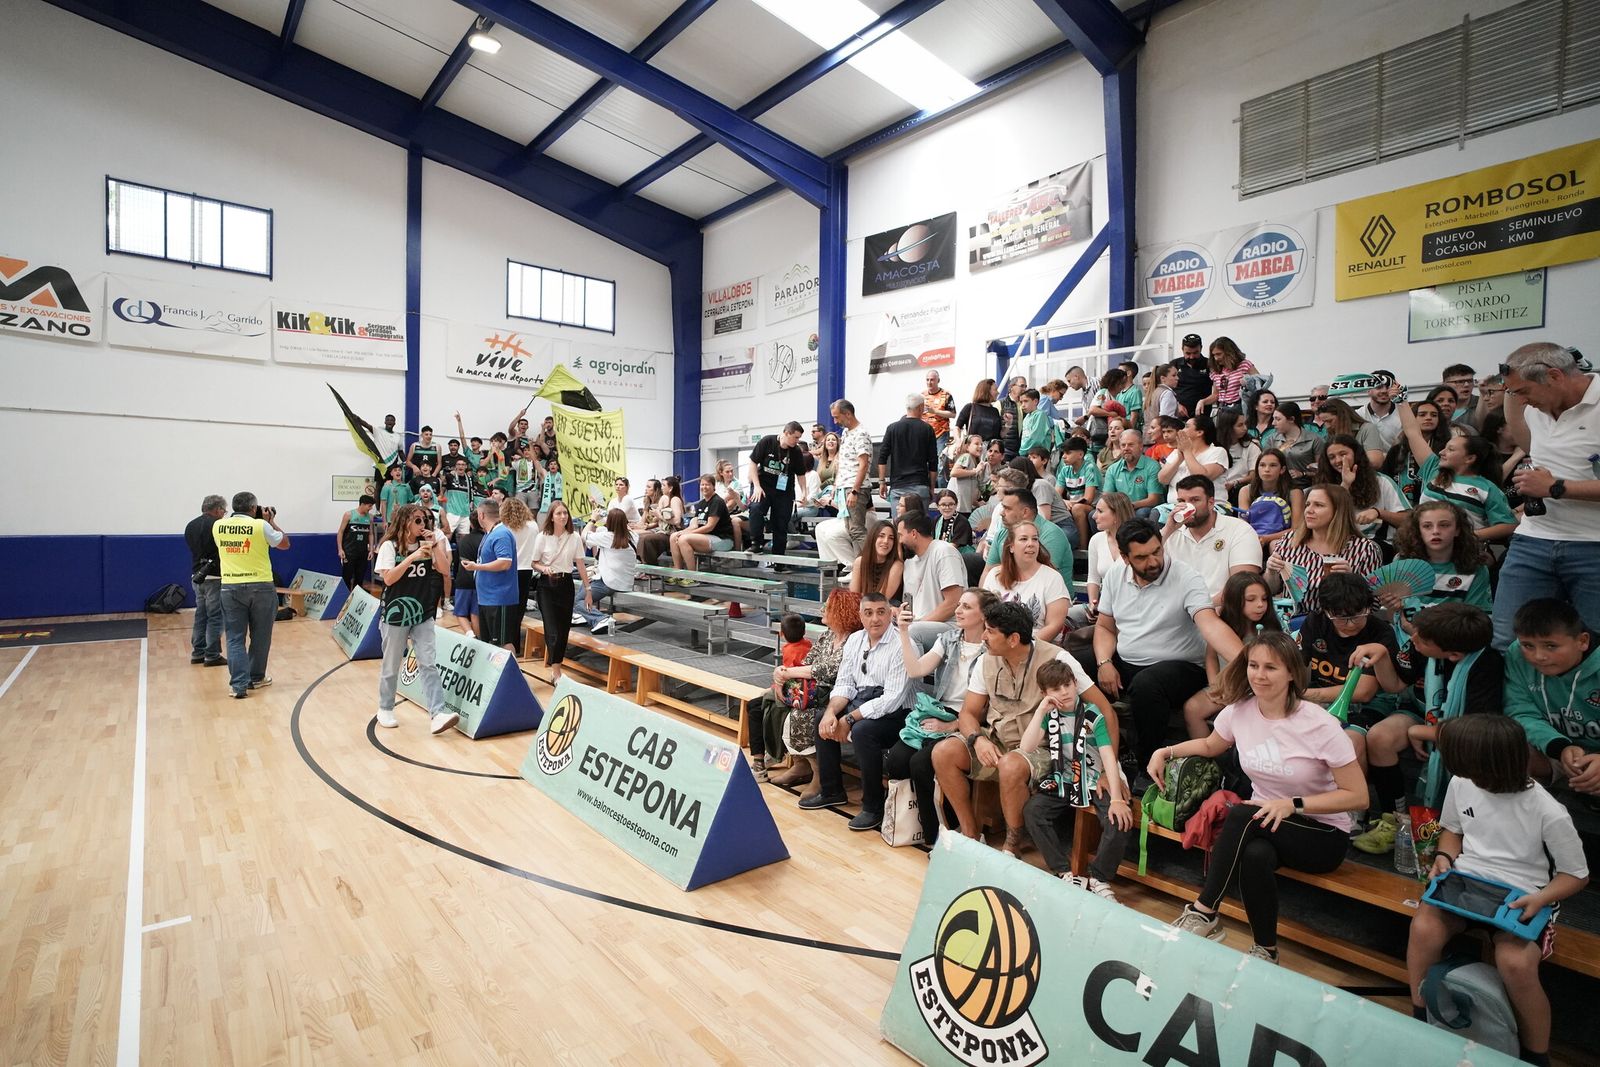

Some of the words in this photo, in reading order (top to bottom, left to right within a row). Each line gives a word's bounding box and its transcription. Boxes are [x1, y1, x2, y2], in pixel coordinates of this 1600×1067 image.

[1425, 170, 1585, 219] ROMBOSOL
[1424, 217, 1458, 229] Estepona
[1464, 209, 1499, 221] Marbella
[1505, 198, 1549, 213] Fuengirola
[1557, 189, 1585, 202] Ronda
[1508, 207, 1583, 231] SEMINUEVO
[1435, 230, 1475, 246] NUEVO
[1435, 240, 1487, 257] OCASIÓN
[1242, 239, 1288, 260] RADIO
[875, 258, 940, 283] AMACOSTA
[1160, 257, 1200, 275] RADIO
[1235, 255, 1294, 281] MARCA
[1348, 255, 1406, 273] RENAULT
[1421, 259, 1472, 273] rombosol.com
[708, 282, 752, 304] VILLALOBOS
[1153, 271, 1205, 295] MARCA
[1458, 281, 1493, 295] PISTA
[731, 299, 754, 312] ESTEPONA
[1246, 298, 1277, 308] MÁLAGA
[20, 306, 92, 323] EXCAVACIONES
[163, 305, 198, 317] Francis
[200, 310, 206, 320] J.
[227, 313, 263, 325] Garrido
[1425, 314, 1470, 329] TORRES
[1473, 306, 1528, 323] BENÍTEZ
[456, 366, 464, 374] la
[466, 368, 492, 378] marca
[494, 371, 507, 379] del
[510, 373, 544, 385] deporte
[589, 359, 656, 376] agrojardín
[218, 524, 253, 535] prensa
[407, 562, 426, 578] 26
[313, 579, 327, 591] CAB
[450, 644, 476, 669] CAB
[435, 663, 484, 706] TEPONA
[538, 737, 571, 771] ESTEPONA
[627, 726, 678, 771] CAB
[578, 744, 702, 838] ESTEPONA
[577, 787, 679, 858] www.baloncestoestepona.com
[915, 967, 1039, 1064] ESTEPONA
